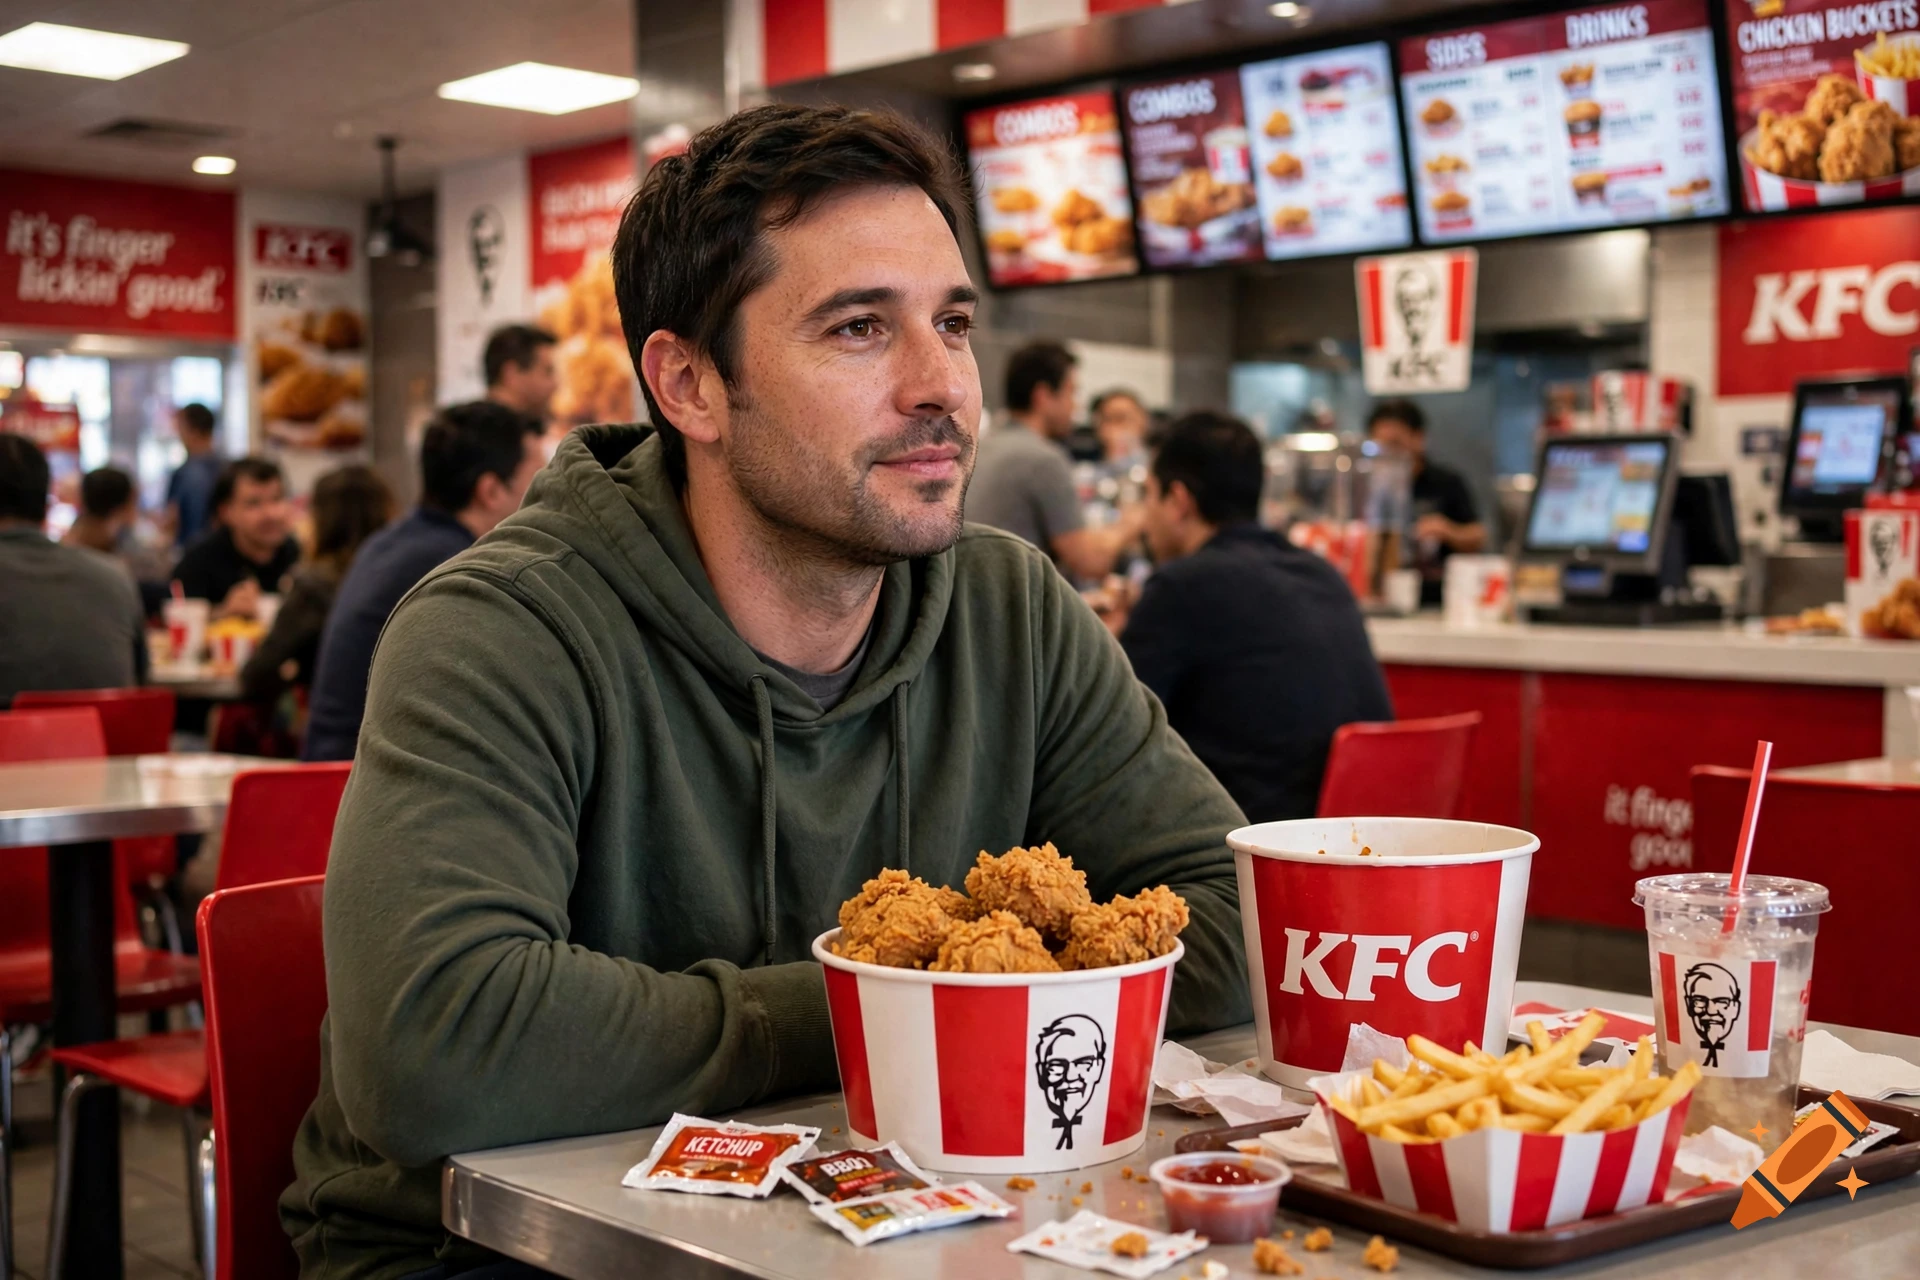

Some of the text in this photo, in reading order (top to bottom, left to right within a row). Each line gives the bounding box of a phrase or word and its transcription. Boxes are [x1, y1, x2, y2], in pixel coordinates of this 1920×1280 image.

[1565, 5, 1649, 48] DRINKS
[1738, 0, 1919, 53] CHICKEN BUCKETS
[1426, 32, 1487, 72] SIDES
[994, 101, 1079, 144] COMBOS
[1129, 81, 1216, 123] COMBOS
[7, 210, 175, 284] it's finger
[1741, 260, 1920, 345] KFC
[1280, 927, 1468, 1002] KFC
[684, 1135, 764, 1157] KETCHUP
